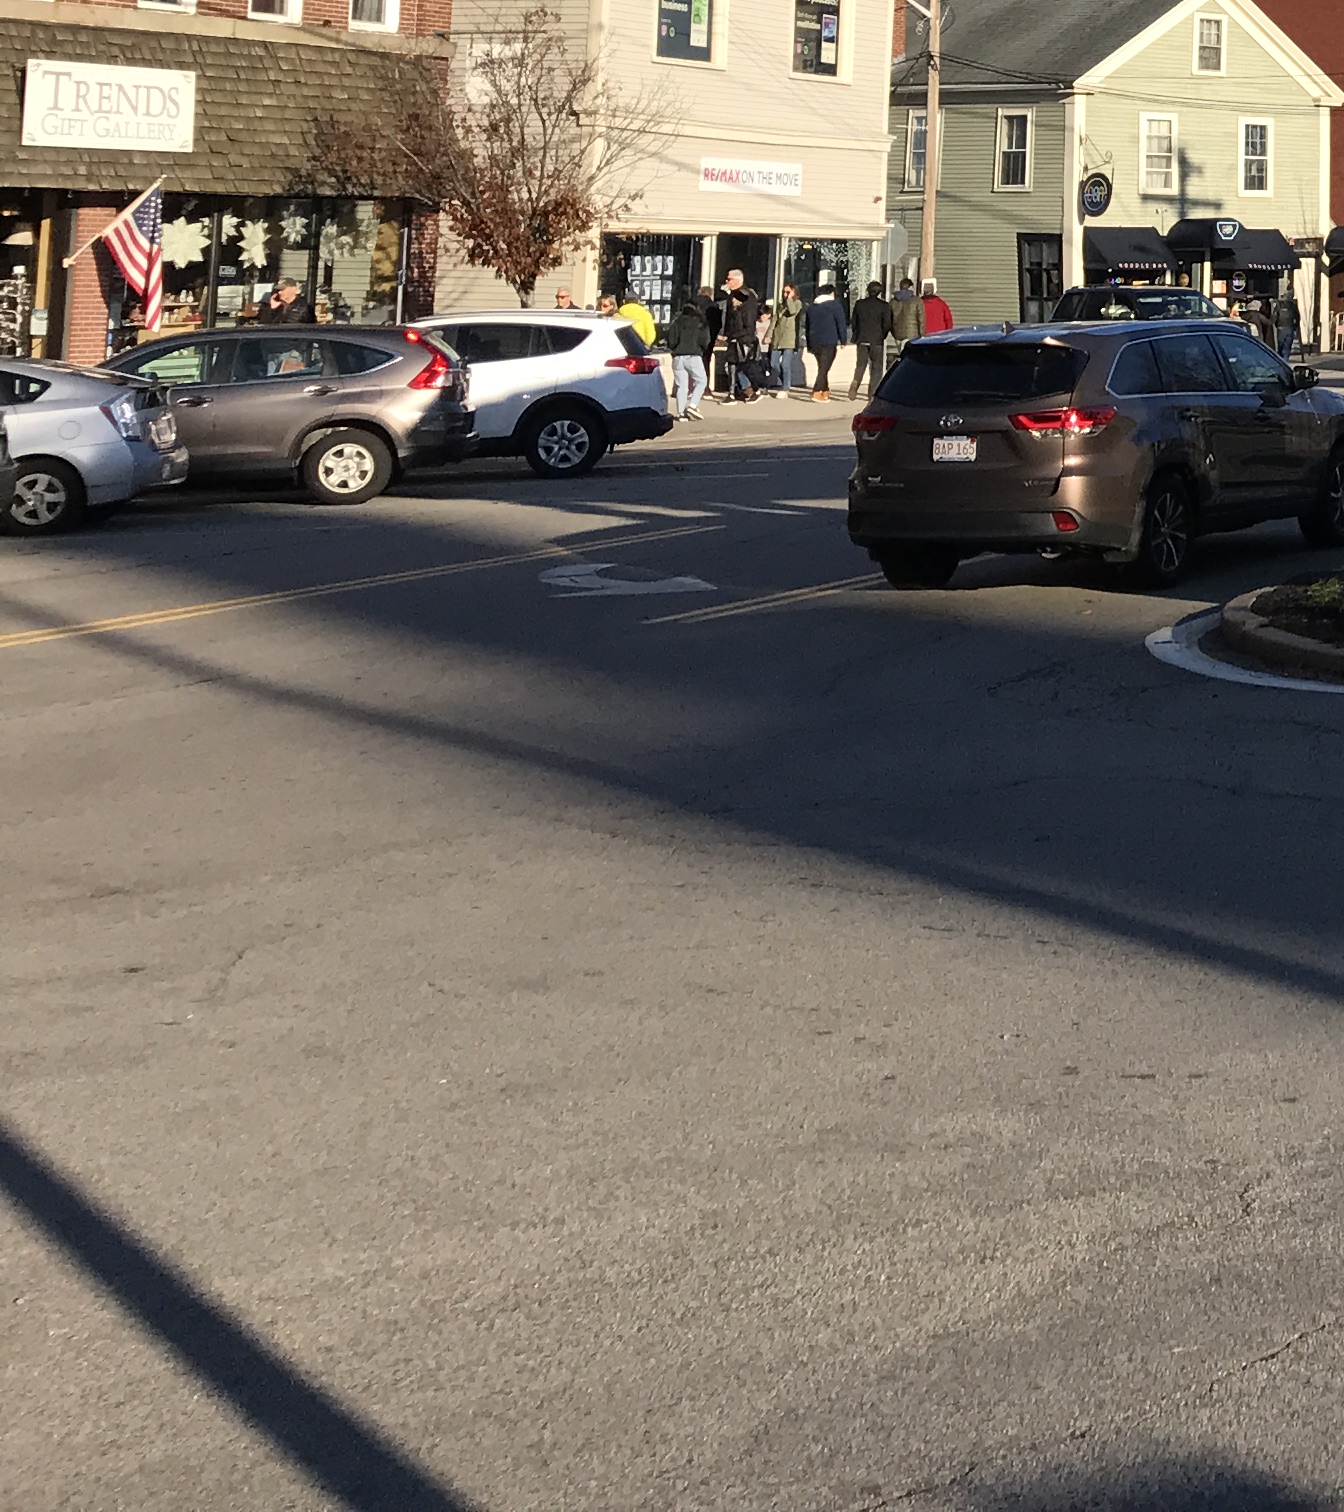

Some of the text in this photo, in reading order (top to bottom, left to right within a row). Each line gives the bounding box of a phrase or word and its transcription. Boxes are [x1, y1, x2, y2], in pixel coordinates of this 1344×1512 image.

[42, 70, 180, 119] TRENDS
[41, 113, 177, 141] GIFT GALLERY
[703, 167, 799, 187] RE/MAX ON THE MOVE
[934, 442, 975, 456] 8AP 165
